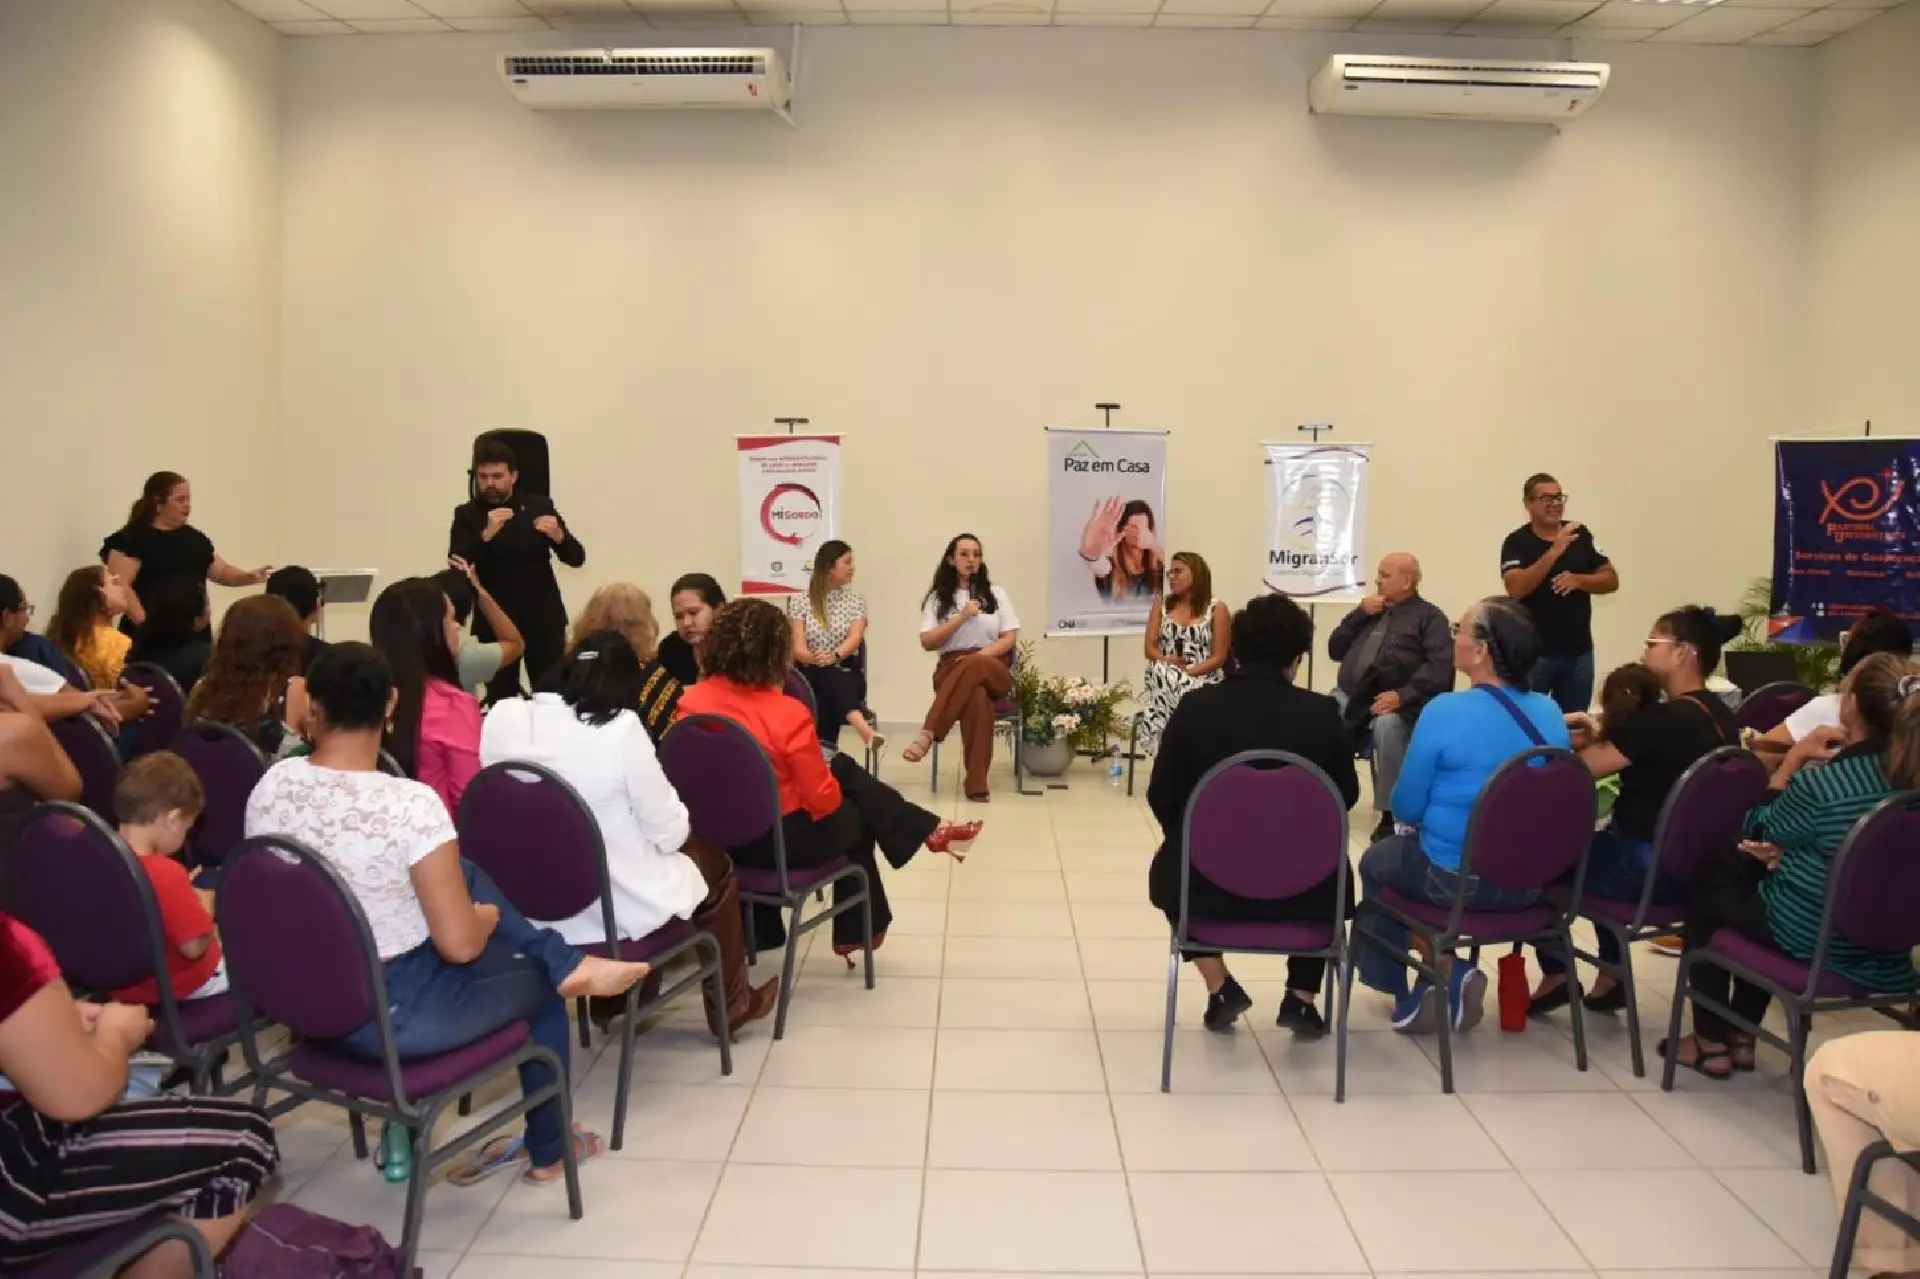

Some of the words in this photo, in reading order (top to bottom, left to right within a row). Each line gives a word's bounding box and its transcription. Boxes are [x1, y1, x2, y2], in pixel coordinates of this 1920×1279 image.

[1064, 458, 1089, 472] Paz
[1091, 461, 1114, 472] em
[1117, 458, 1150, 473] Casa
